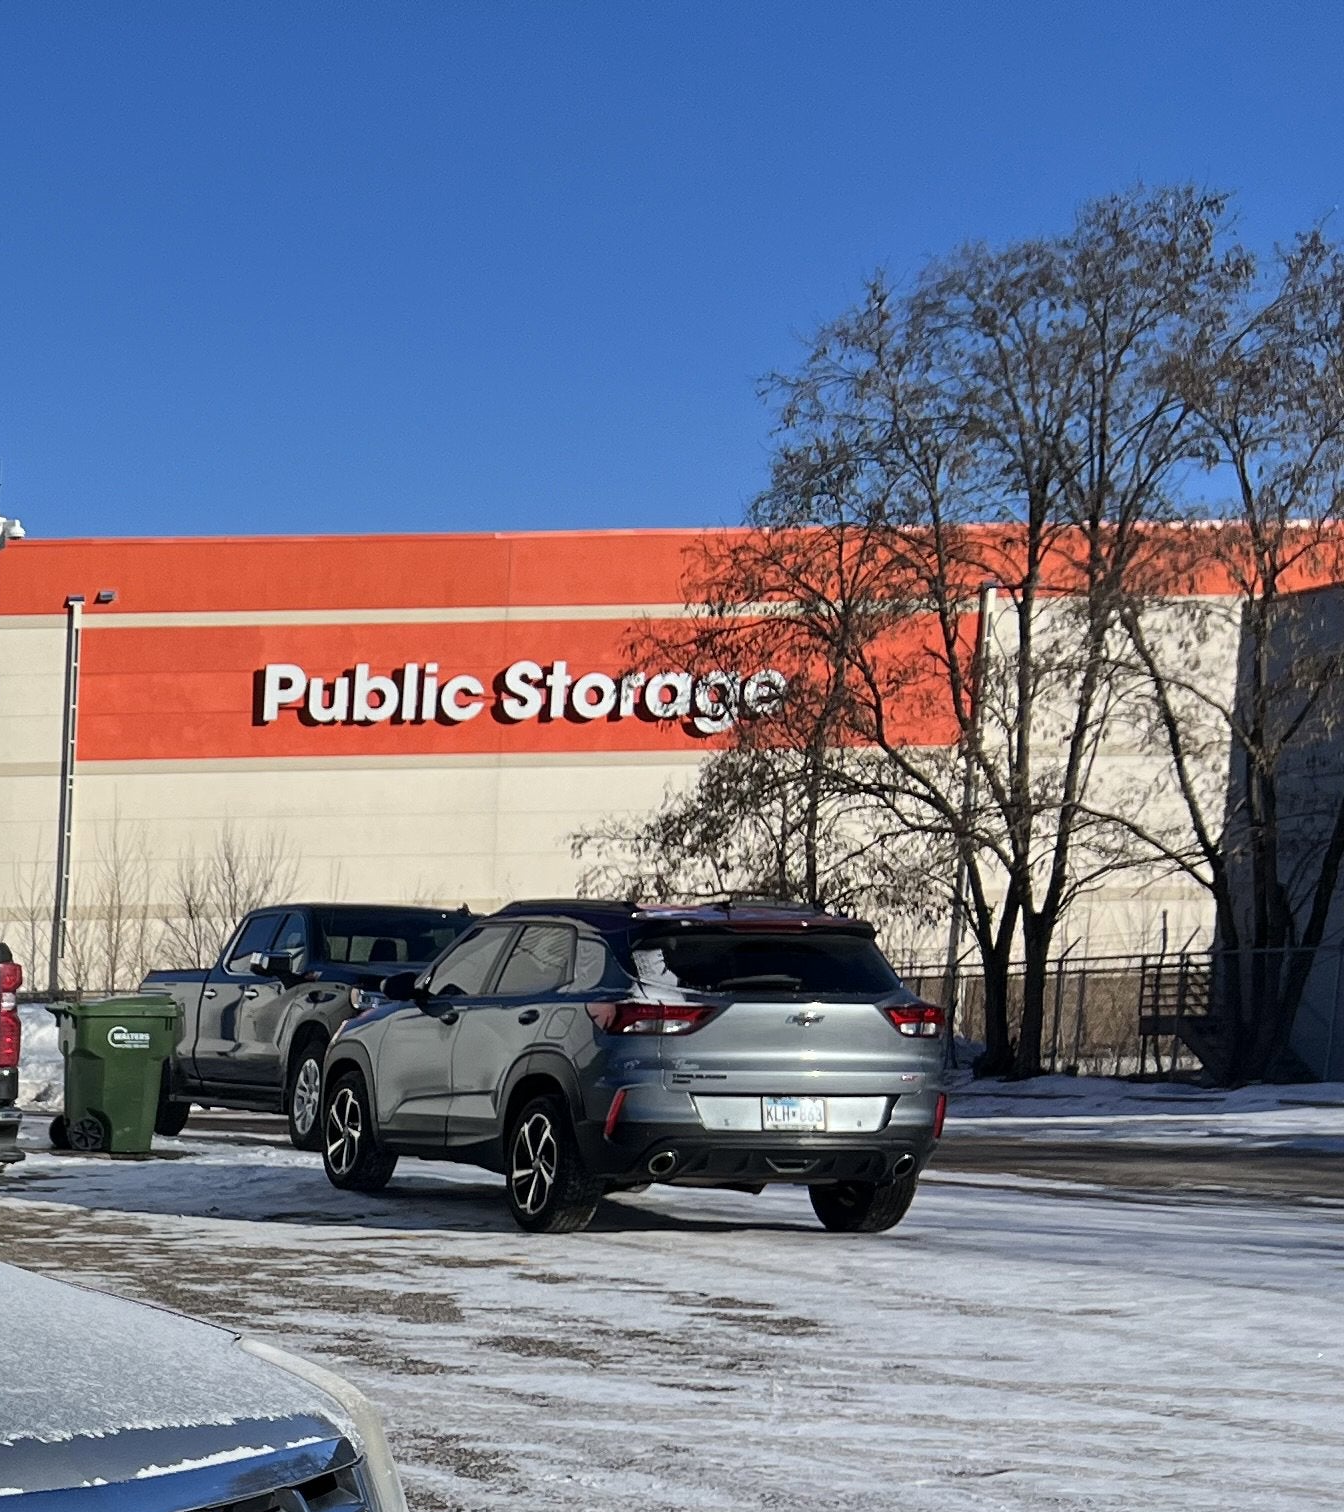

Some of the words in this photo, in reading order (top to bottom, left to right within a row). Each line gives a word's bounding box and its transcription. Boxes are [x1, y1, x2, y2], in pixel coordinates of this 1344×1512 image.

[263, 663, 484, 722] Public
[503, 661, 787, 734] Storage
[113, 1032, 150, 1041] WALTERS
